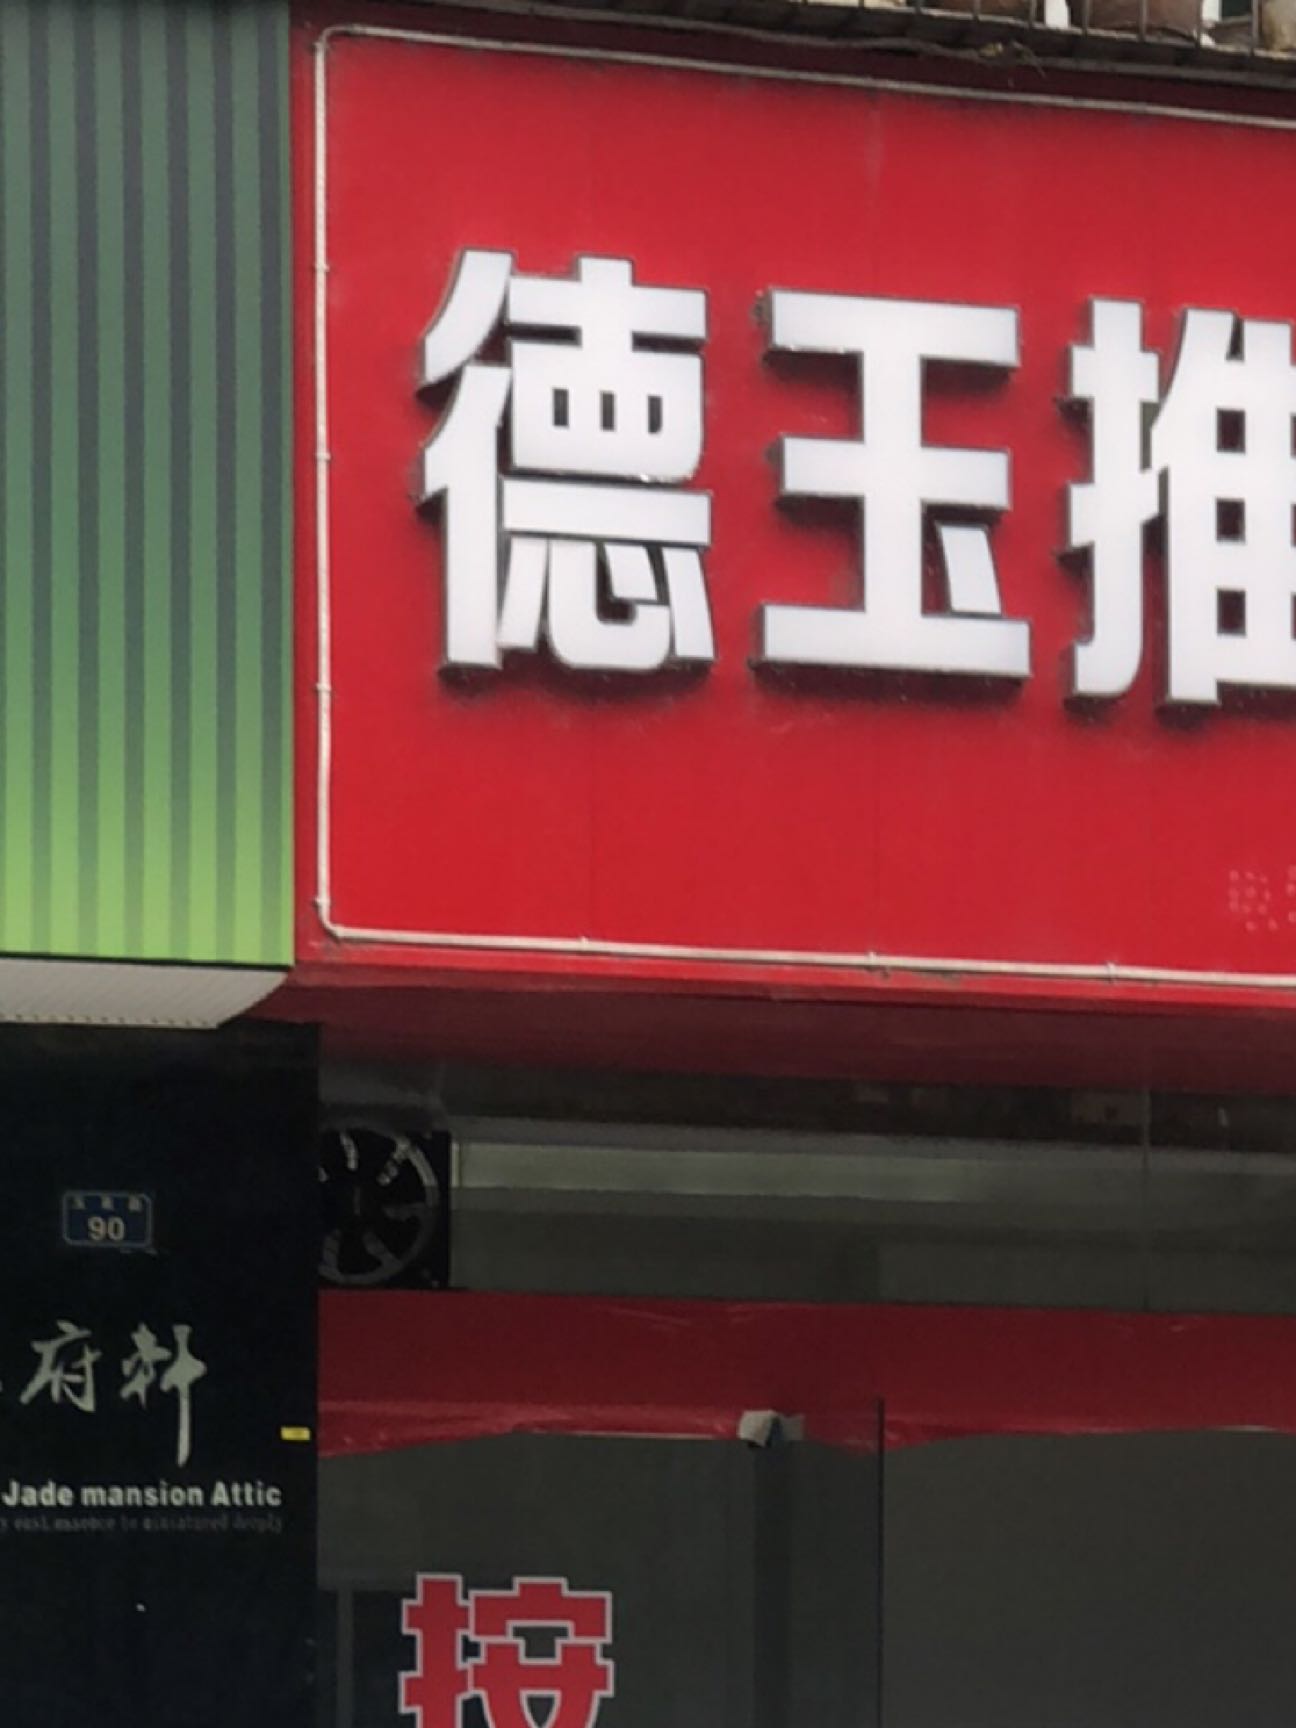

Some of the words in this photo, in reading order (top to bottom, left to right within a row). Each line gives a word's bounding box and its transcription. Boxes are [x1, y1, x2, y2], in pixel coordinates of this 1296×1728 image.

[87, 1216, 126, 1242] 90
[0, 1319, 207, 1468] 府轩
[2, 1480, 74, 1507] Jade
[81, 1481, 204, 1507] mansion
[211, 1480, 283, 1507] Attic
